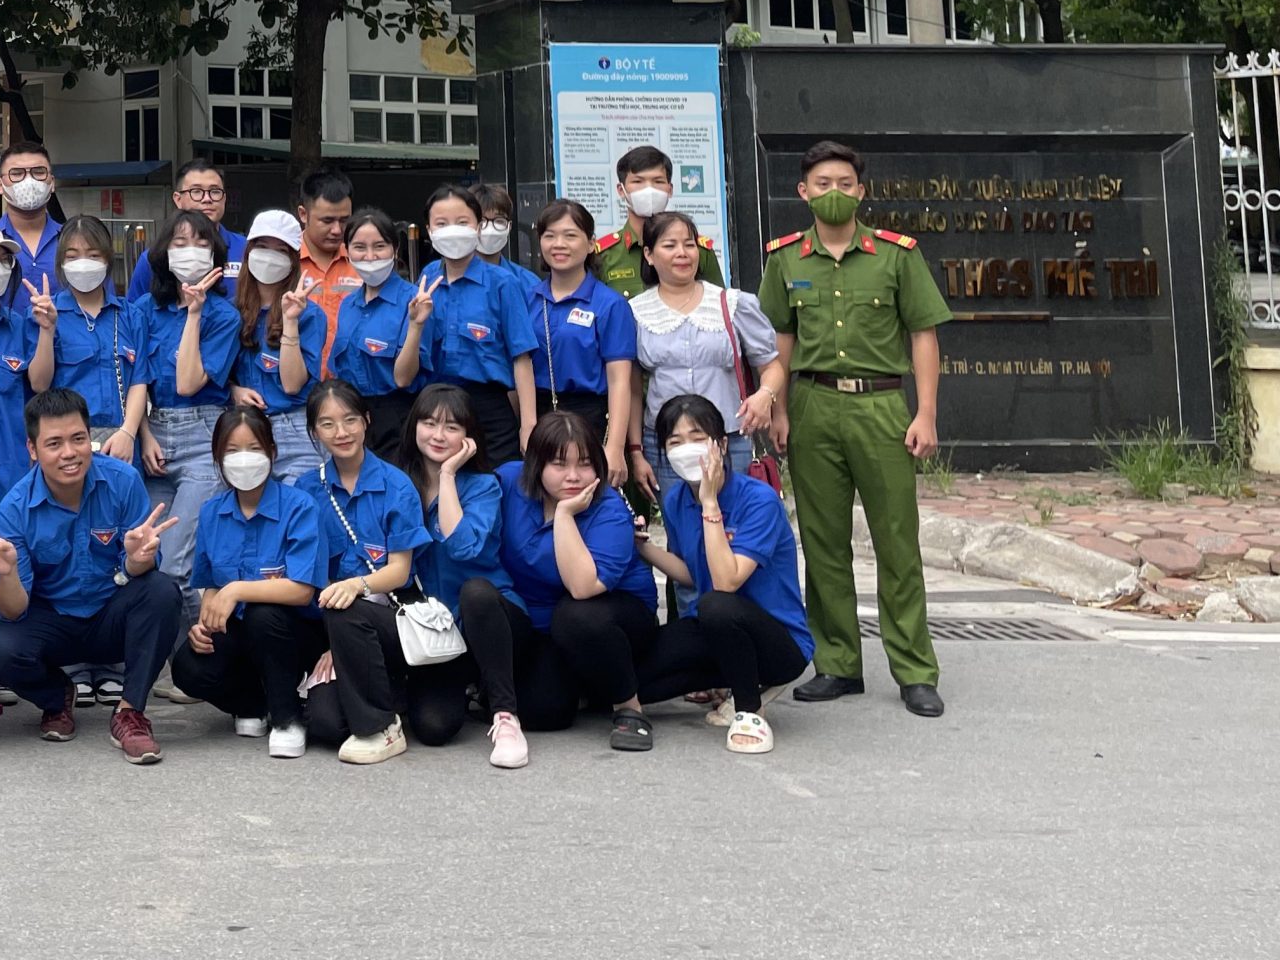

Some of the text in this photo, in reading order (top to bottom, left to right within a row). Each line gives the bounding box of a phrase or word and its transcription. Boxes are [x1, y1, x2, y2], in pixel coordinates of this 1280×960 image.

[615, 56, 656, 72] BỘ Y TẾ
[582, 72, 609, 82] Đường
[610, 72, 625, 82] dây
